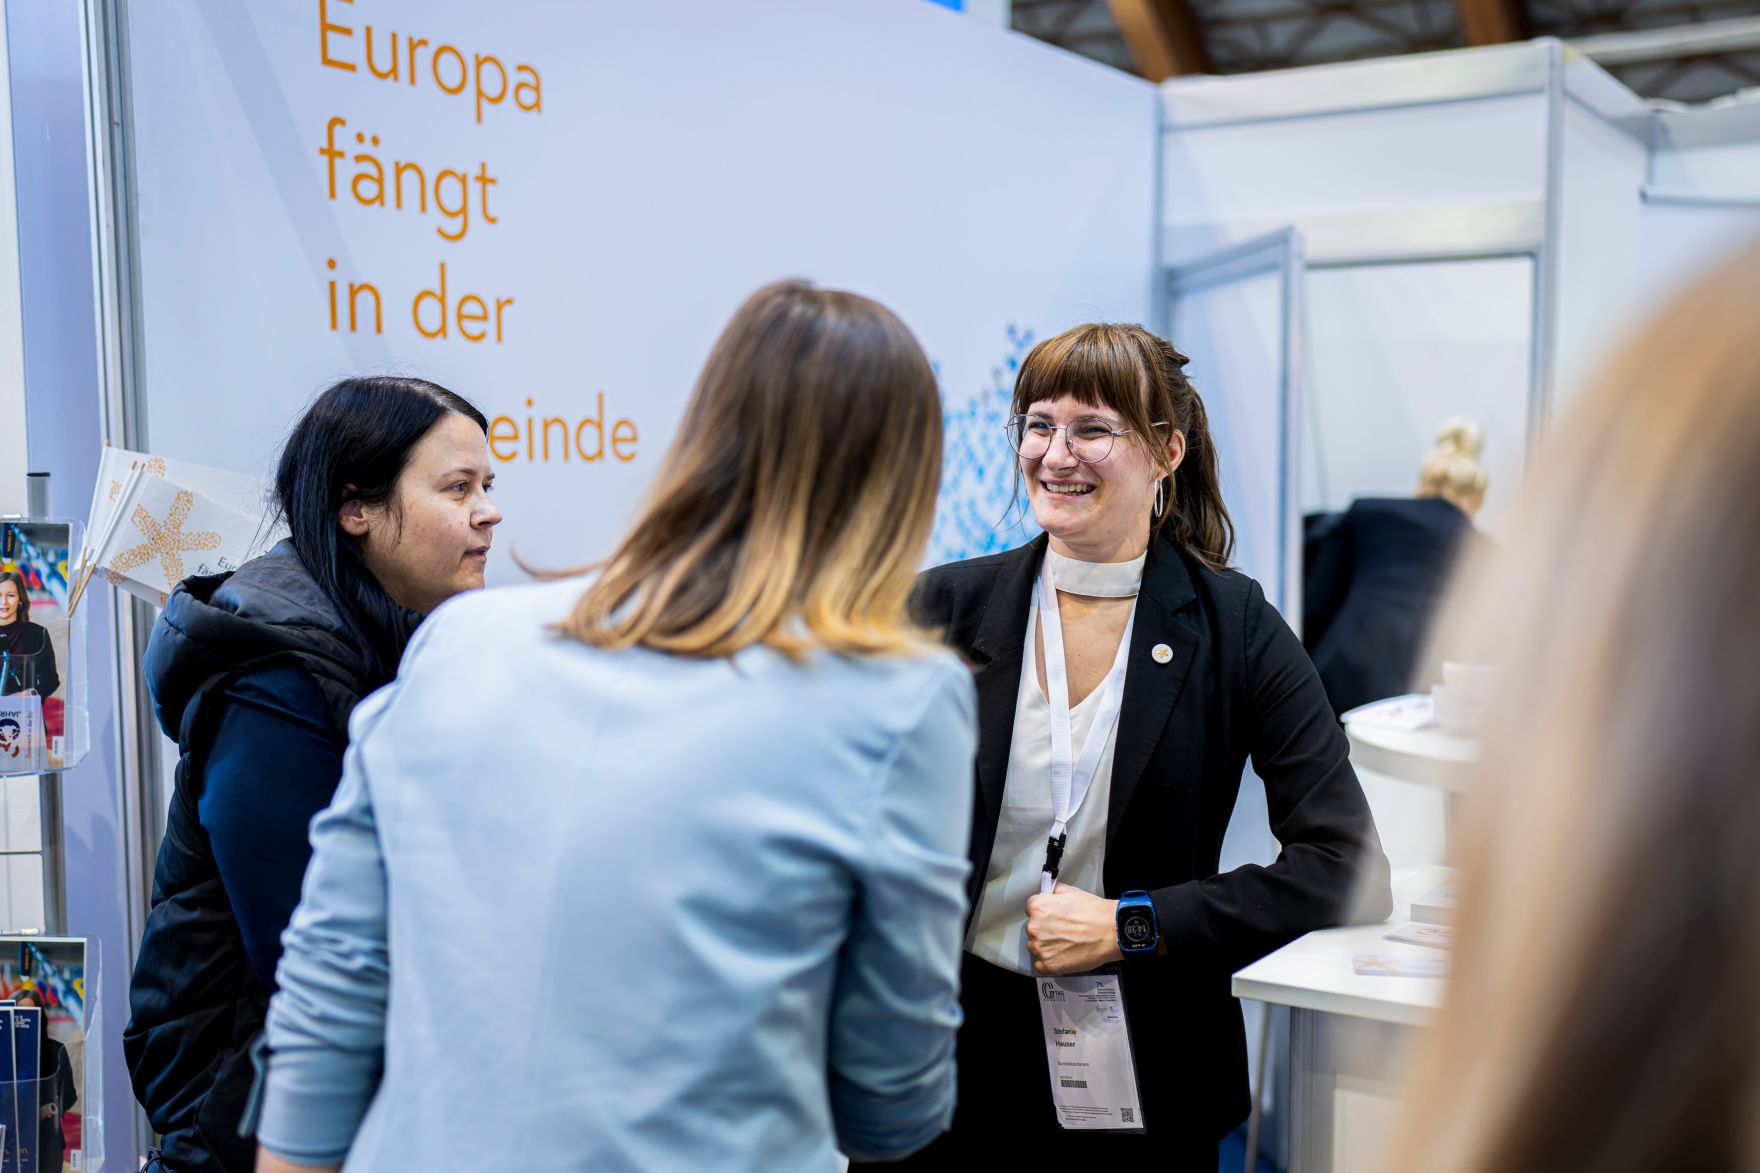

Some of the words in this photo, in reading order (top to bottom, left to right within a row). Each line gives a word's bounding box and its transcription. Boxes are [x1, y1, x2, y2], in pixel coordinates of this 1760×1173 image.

[319, 0, 542, 124] Europa
[319, 115, 498, 242] fängt
[326, 259, 383, 335] in
[411, 261, 514, 344] der
[489, 392, 639, 463] einde
[217, 555, 236, 571] Eur
[1053, 1027, 1077, 1036] Stefanie
[1055, 1040, 1076, 1048] Hauser
